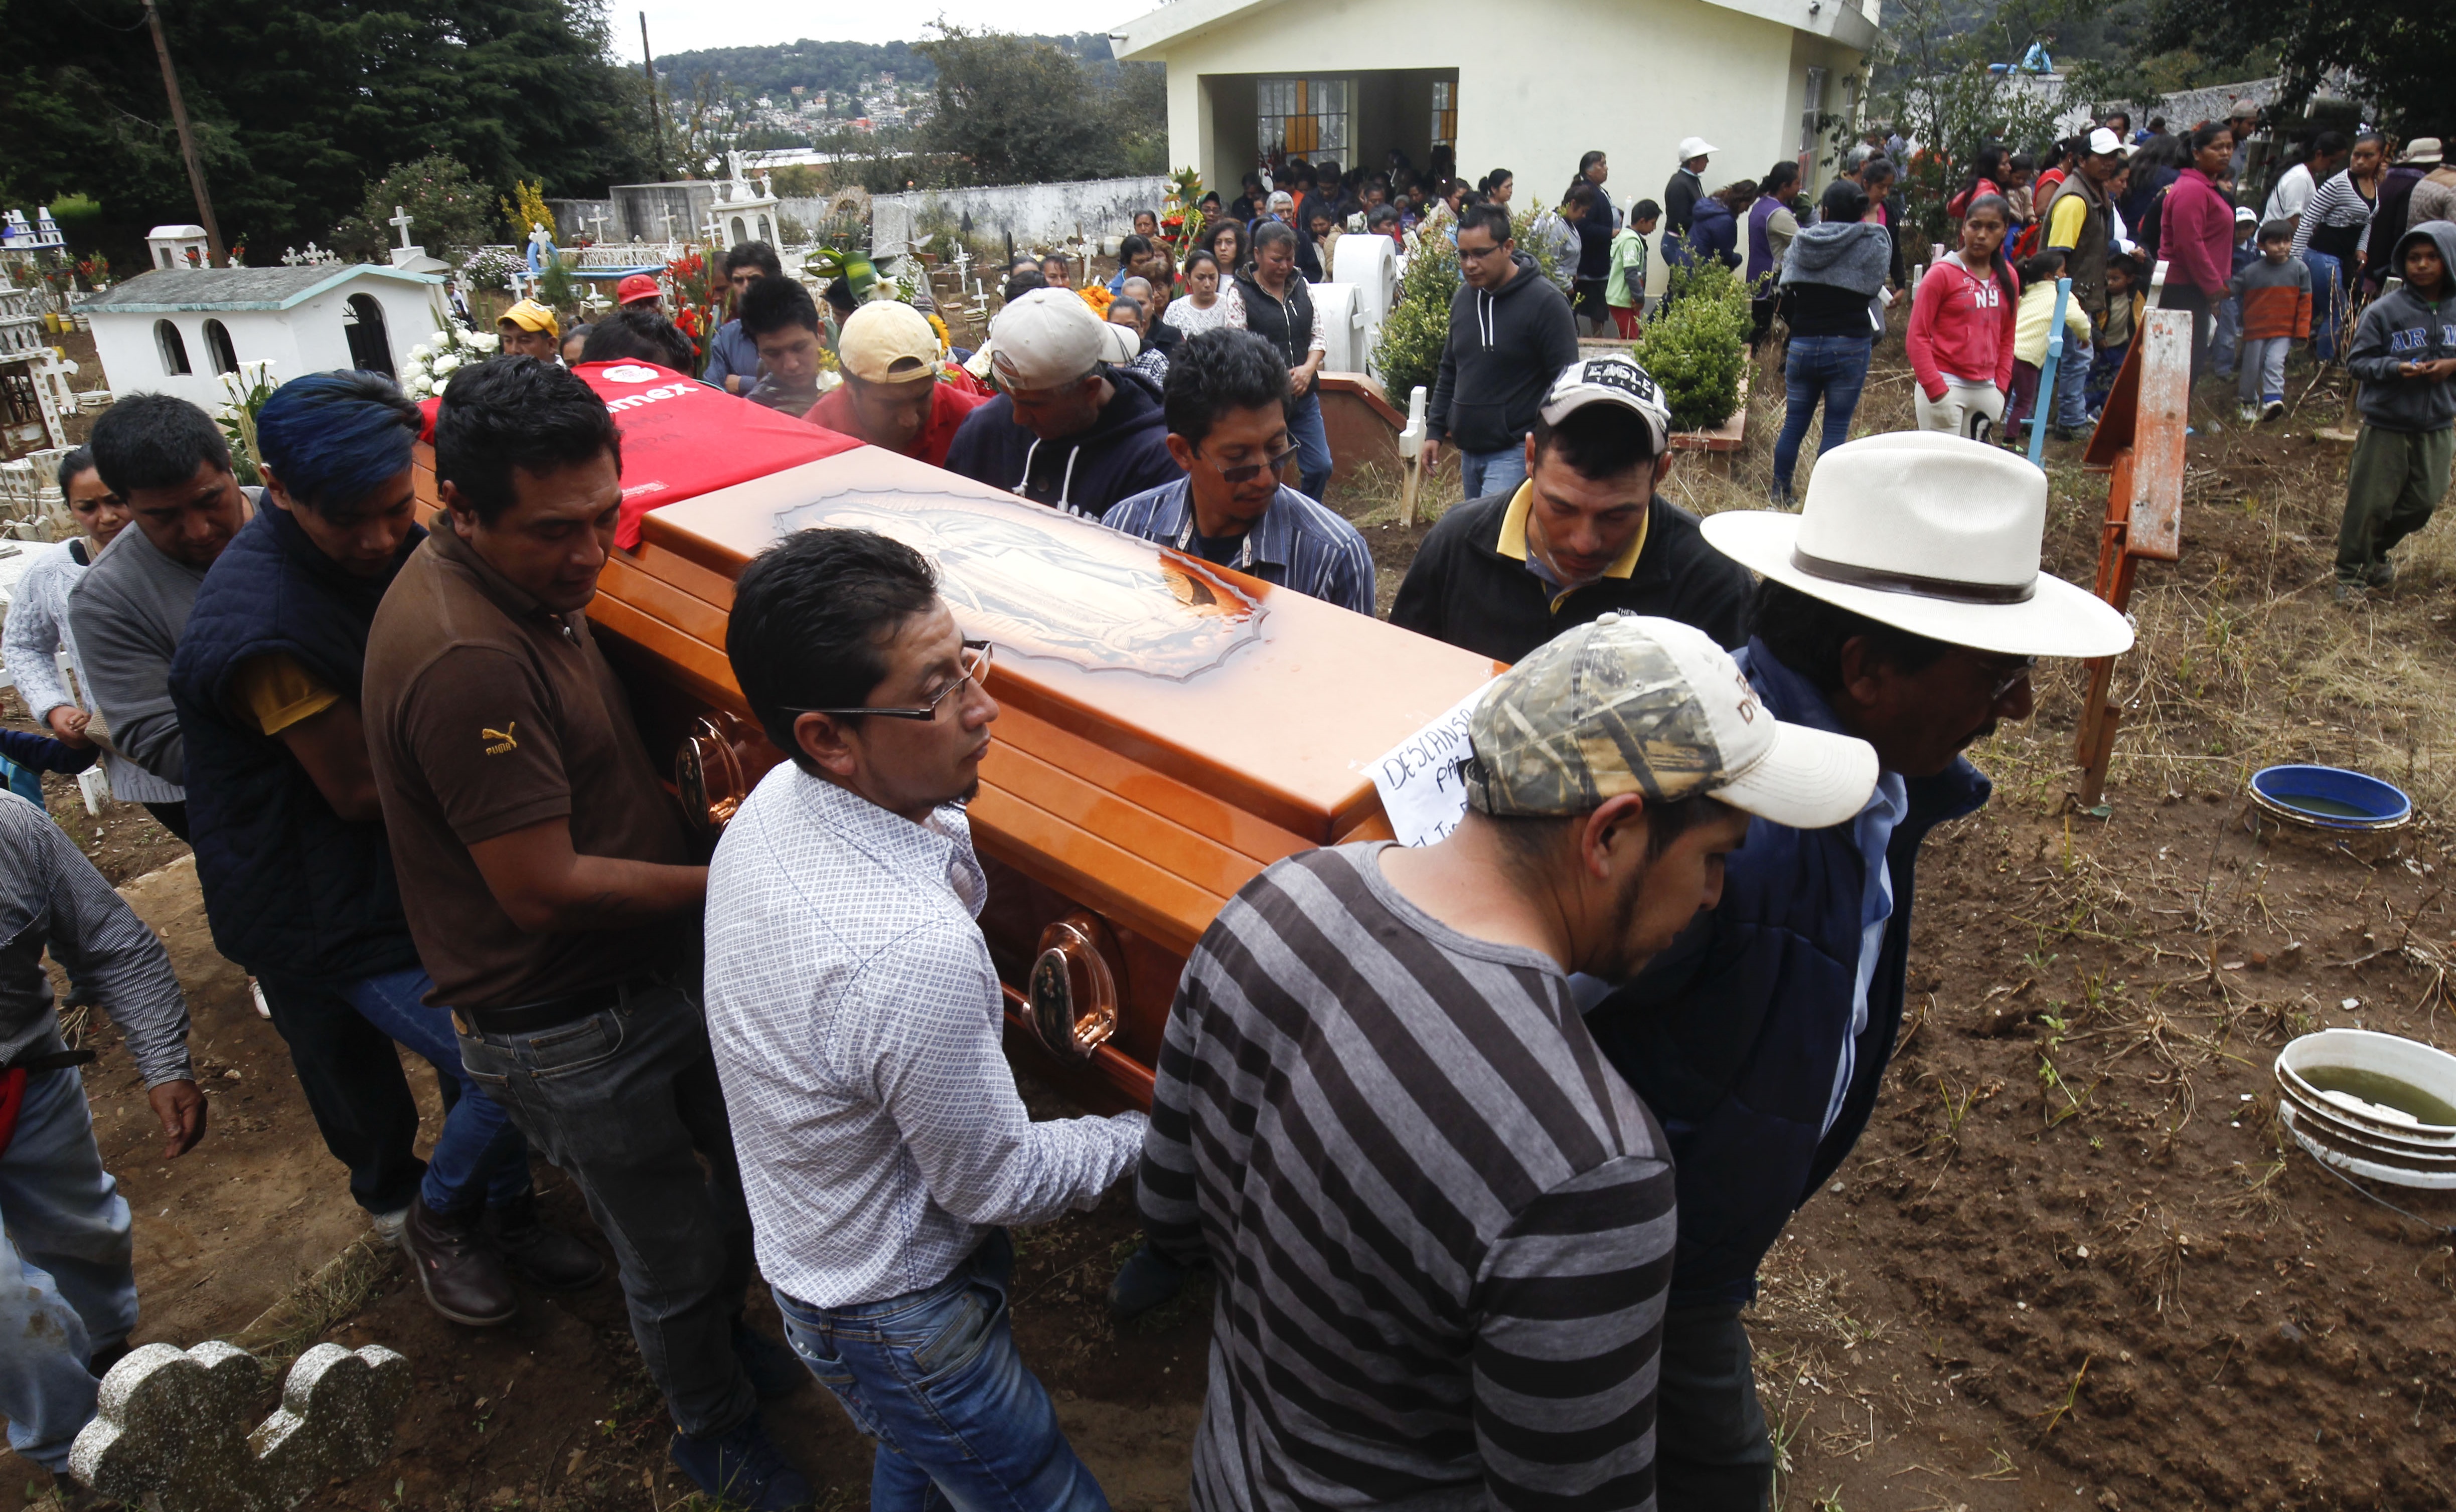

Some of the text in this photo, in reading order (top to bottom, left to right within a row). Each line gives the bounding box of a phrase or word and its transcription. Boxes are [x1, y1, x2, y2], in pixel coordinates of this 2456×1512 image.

[1974, 289, 1999, 308] NY
[1587, 363, 1651, 393] EAGLE
[1596, 376, 1646, 397] TALON
[486, 742, 512, 756] PUMA
